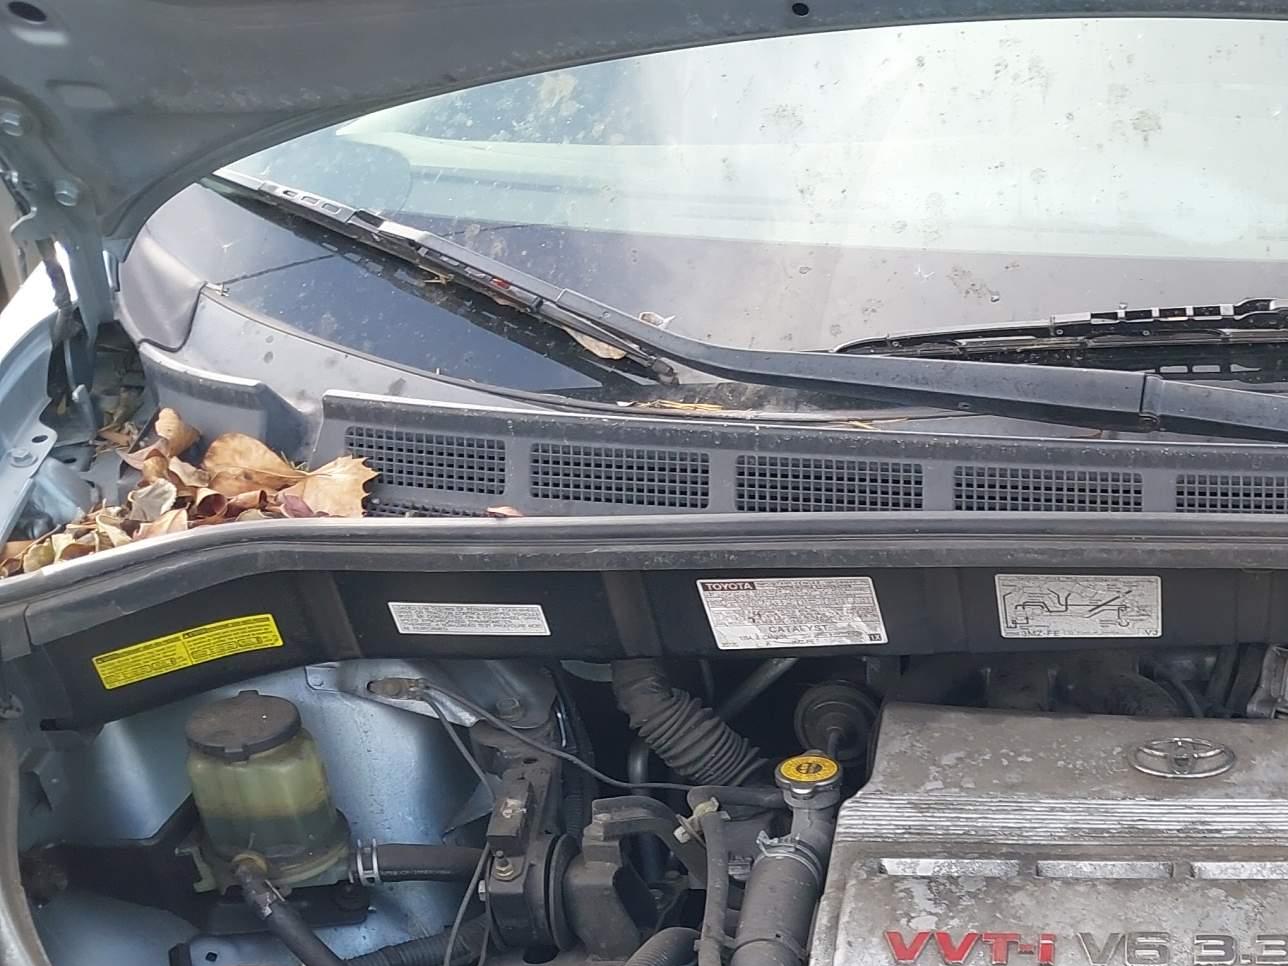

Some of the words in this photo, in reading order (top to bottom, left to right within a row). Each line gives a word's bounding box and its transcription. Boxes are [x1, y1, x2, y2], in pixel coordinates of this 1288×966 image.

[704, 582, 752, 591] TOYOTA
[768, 624, 829, 633] CATALYST
[884, 931, 1056, 966] VVT-i
